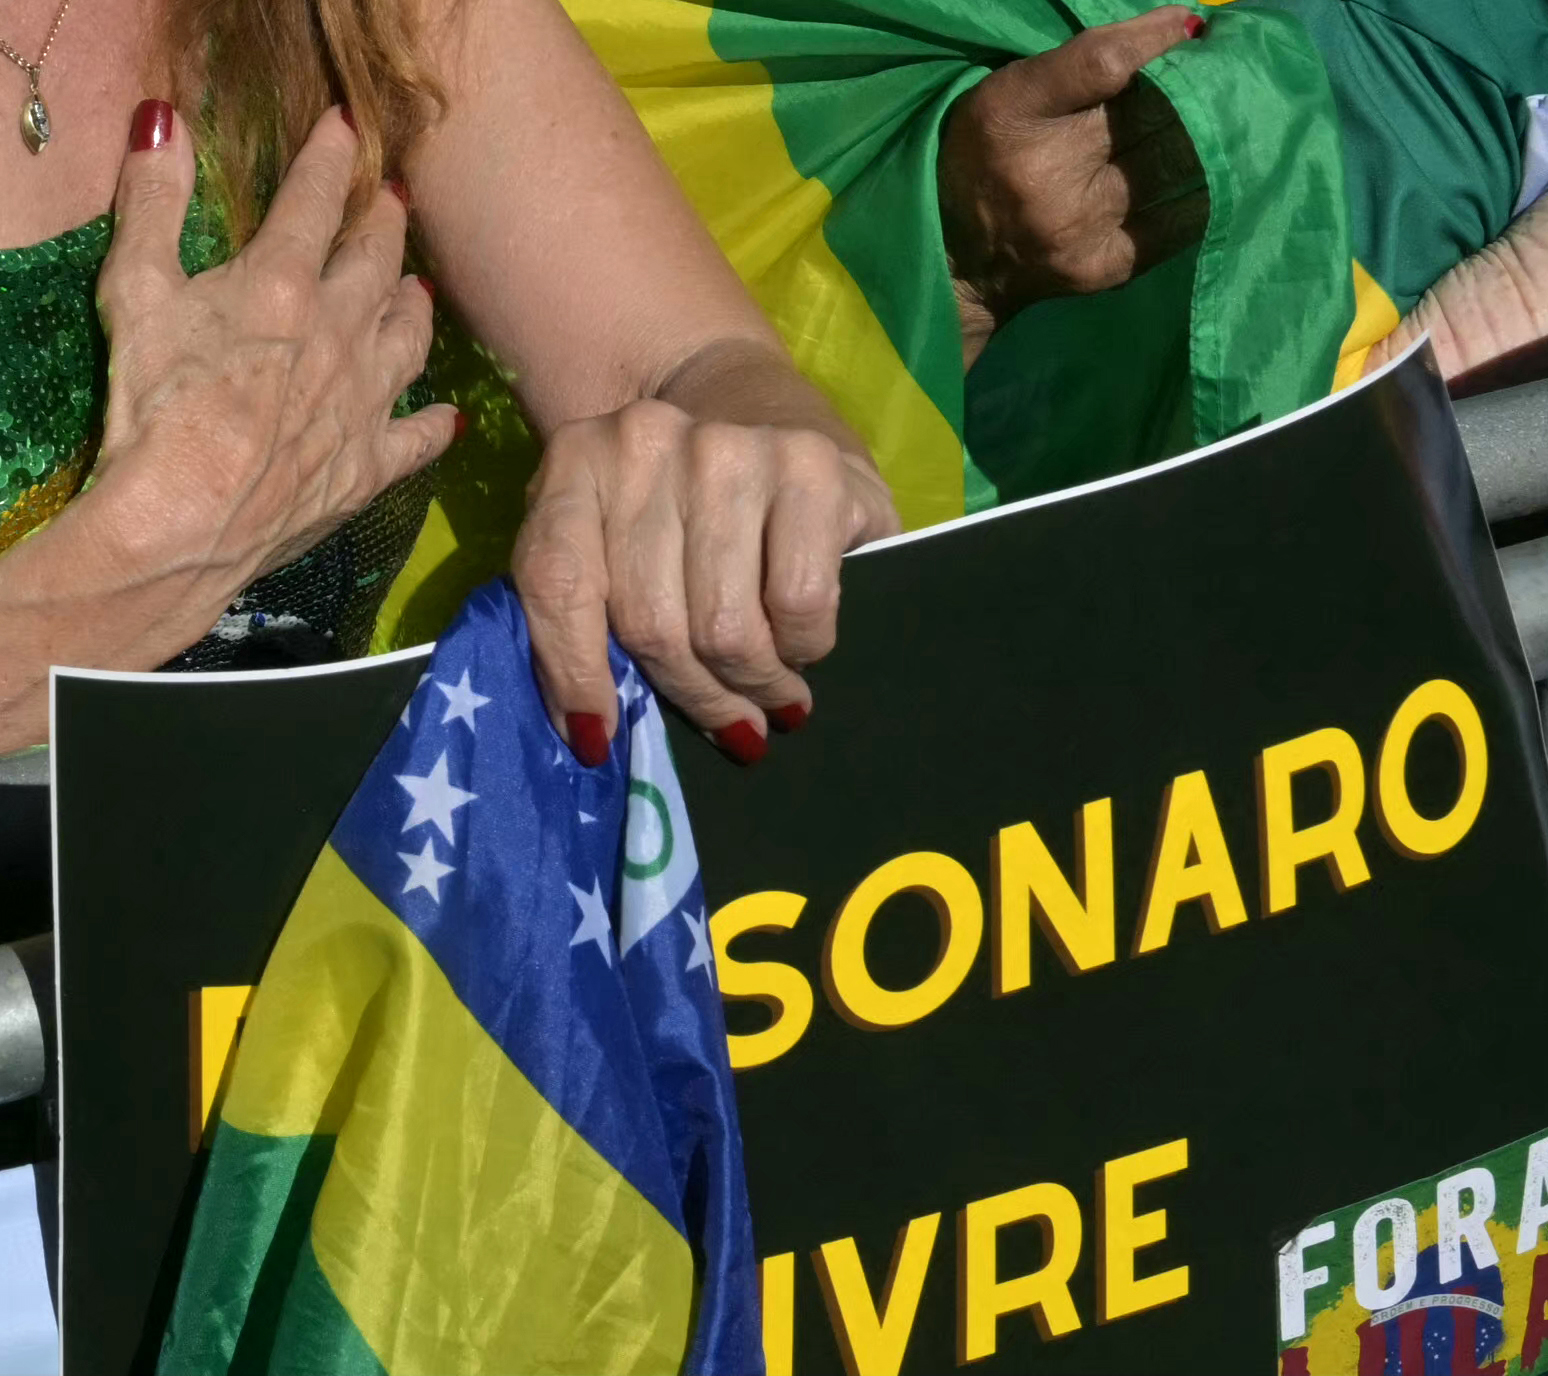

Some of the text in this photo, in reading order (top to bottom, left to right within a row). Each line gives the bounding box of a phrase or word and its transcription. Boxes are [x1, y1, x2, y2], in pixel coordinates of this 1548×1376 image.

[1370, 1295, 1501, 1325] ORDEM E PROGRESSO
